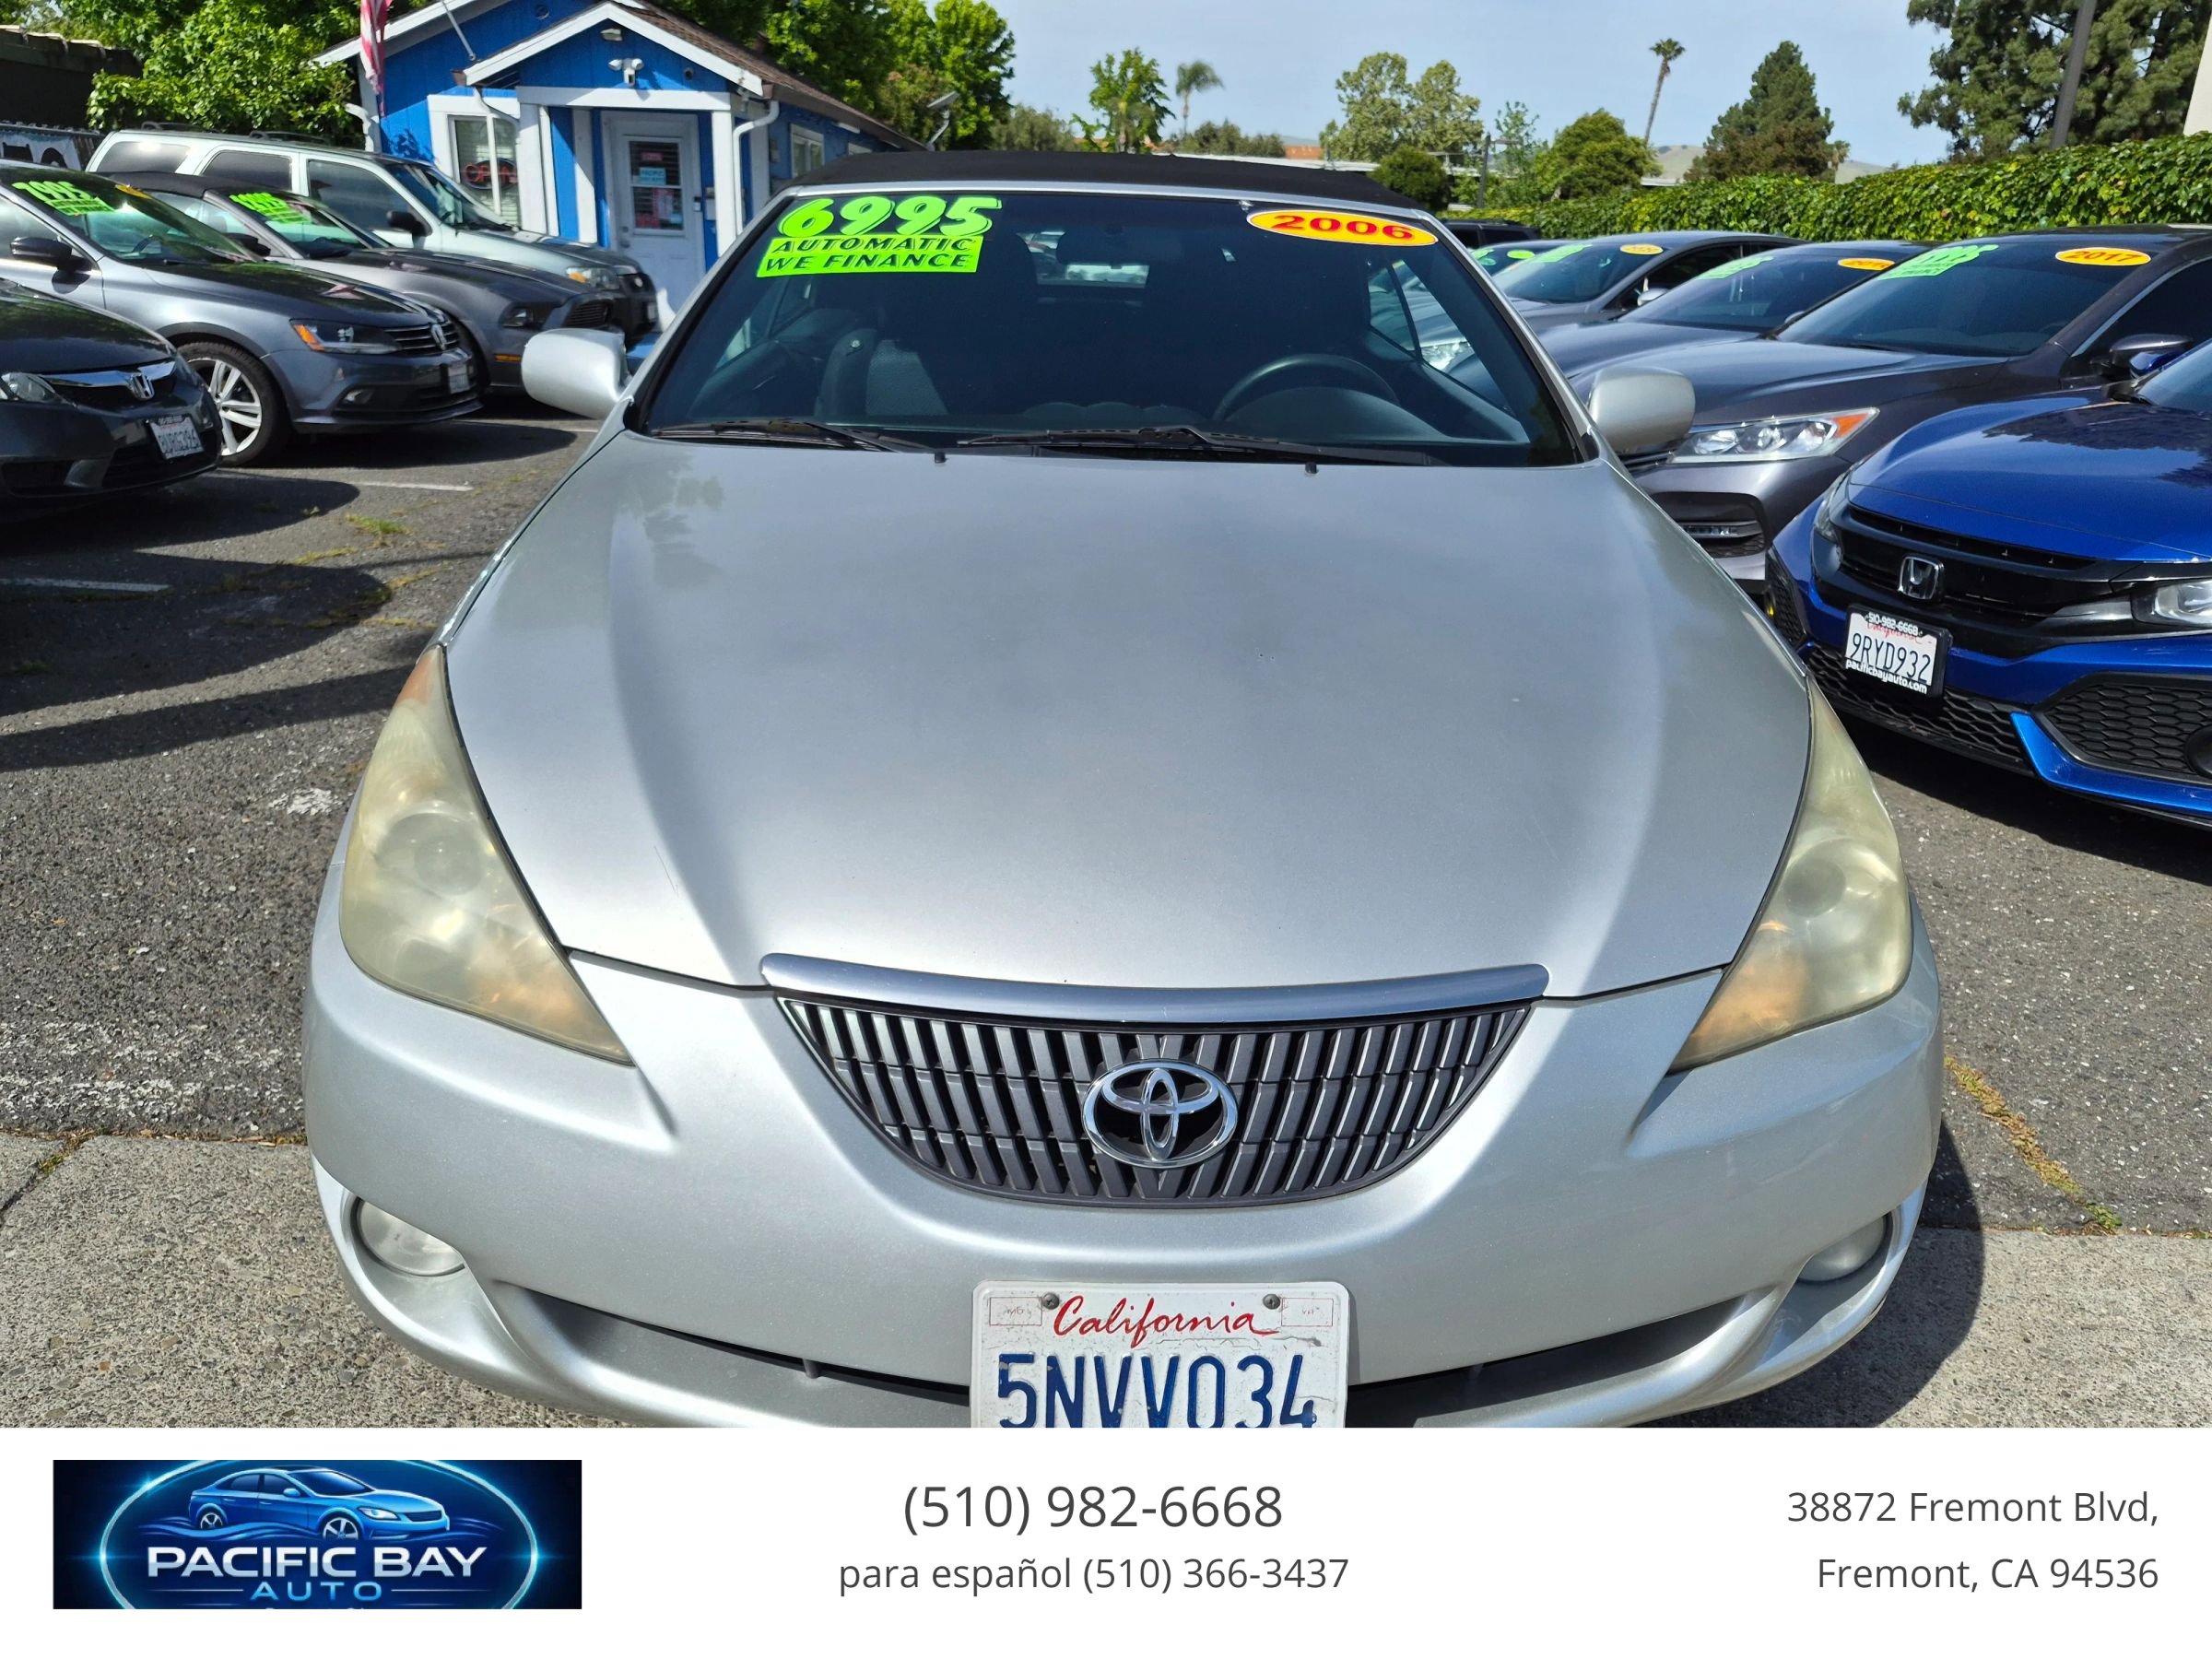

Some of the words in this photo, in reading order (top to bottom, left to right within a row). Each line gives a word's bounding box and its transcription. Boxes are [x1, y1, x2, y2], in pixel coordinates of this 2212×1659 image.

[778, 196, 1002, 237] 6995
[1270, 215, 1414, 240] 2006
[772, 237, 975, 253] AUTOMATIC
[2072, 250, 2144, 263] 2017
[766, 255, 815, 271] WE
[823, 253, 973, 268] FINANCE
[1868, 612, 1919, 636] 510-982-6668
[1851, 632, 1931, 684] 9RYD932
[1845, 659, 1928, 694] pacificbayauto.com
[1053, 1295, 1280, 1348] California
[998, 1352, 1318, 1428] 5NVV034
